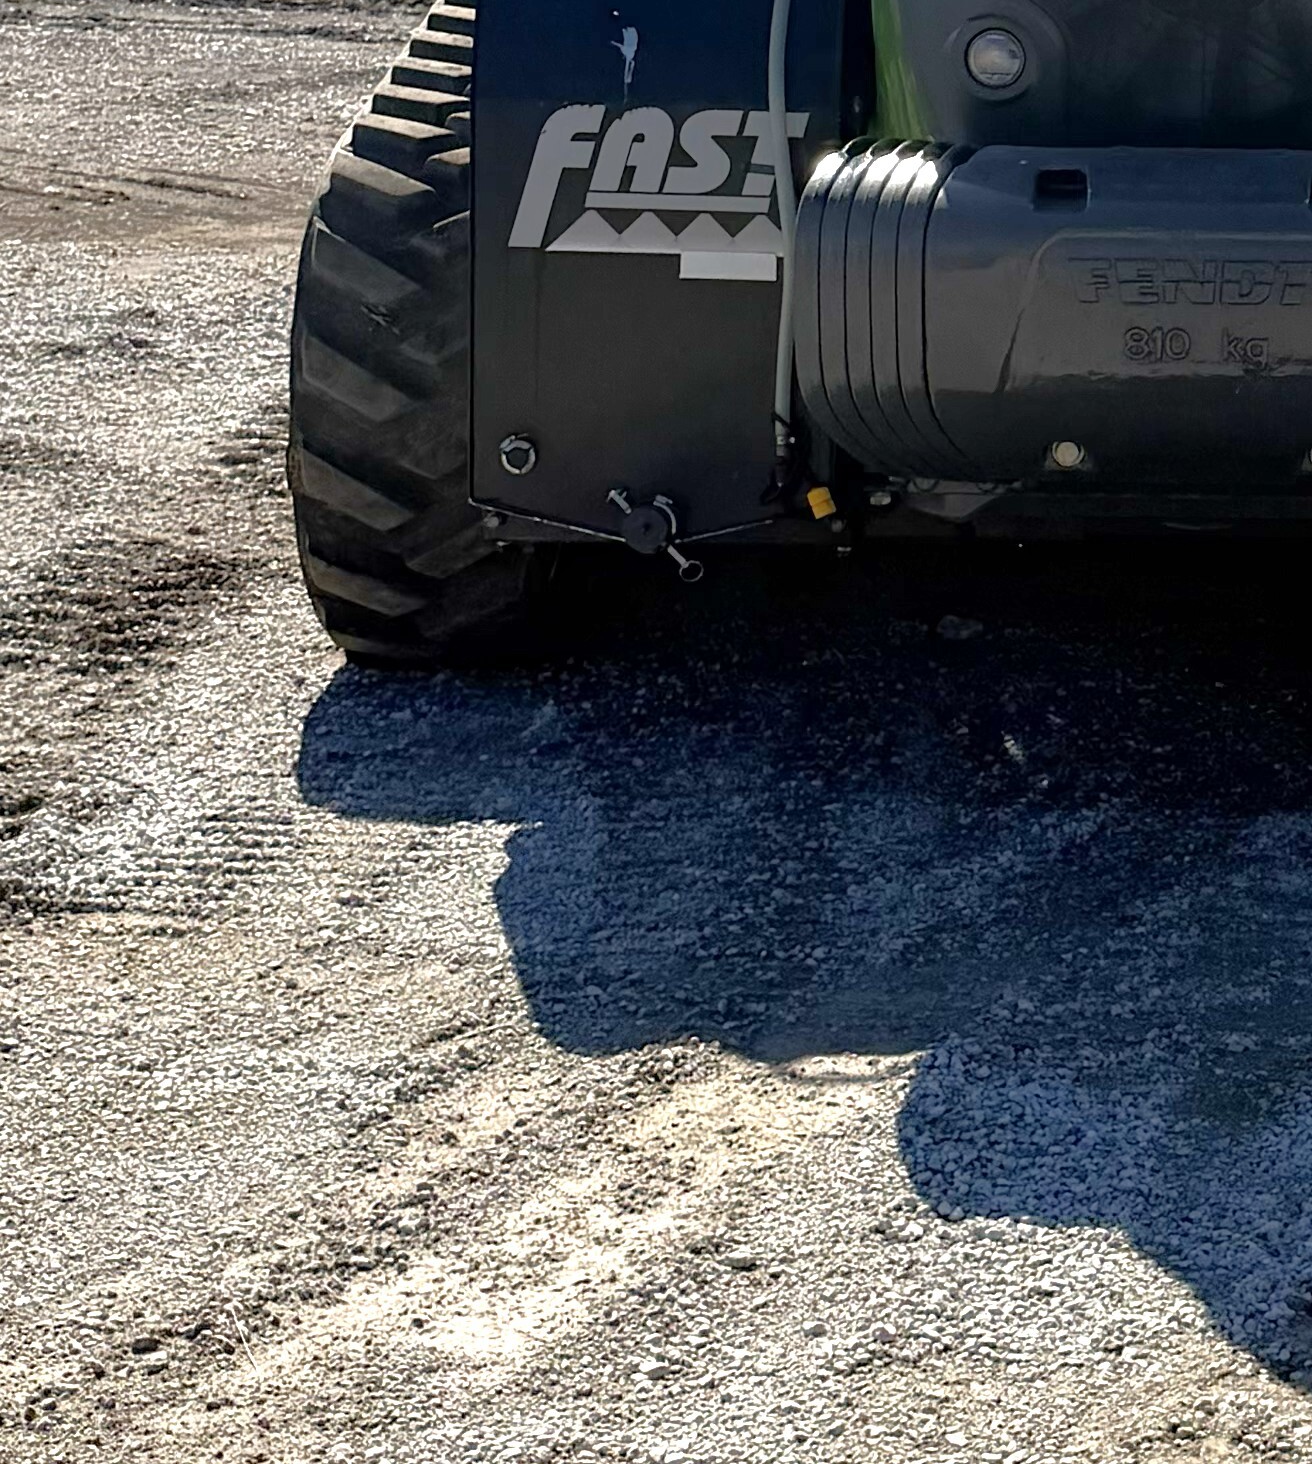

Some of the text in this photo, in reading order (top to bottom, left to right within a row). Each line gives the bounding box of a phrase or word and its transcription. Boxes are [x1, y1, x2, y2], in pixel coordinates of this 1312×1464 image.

[508, 103, 809, 247] FAST
[1124, 326, 1269, 368] 810 kg
